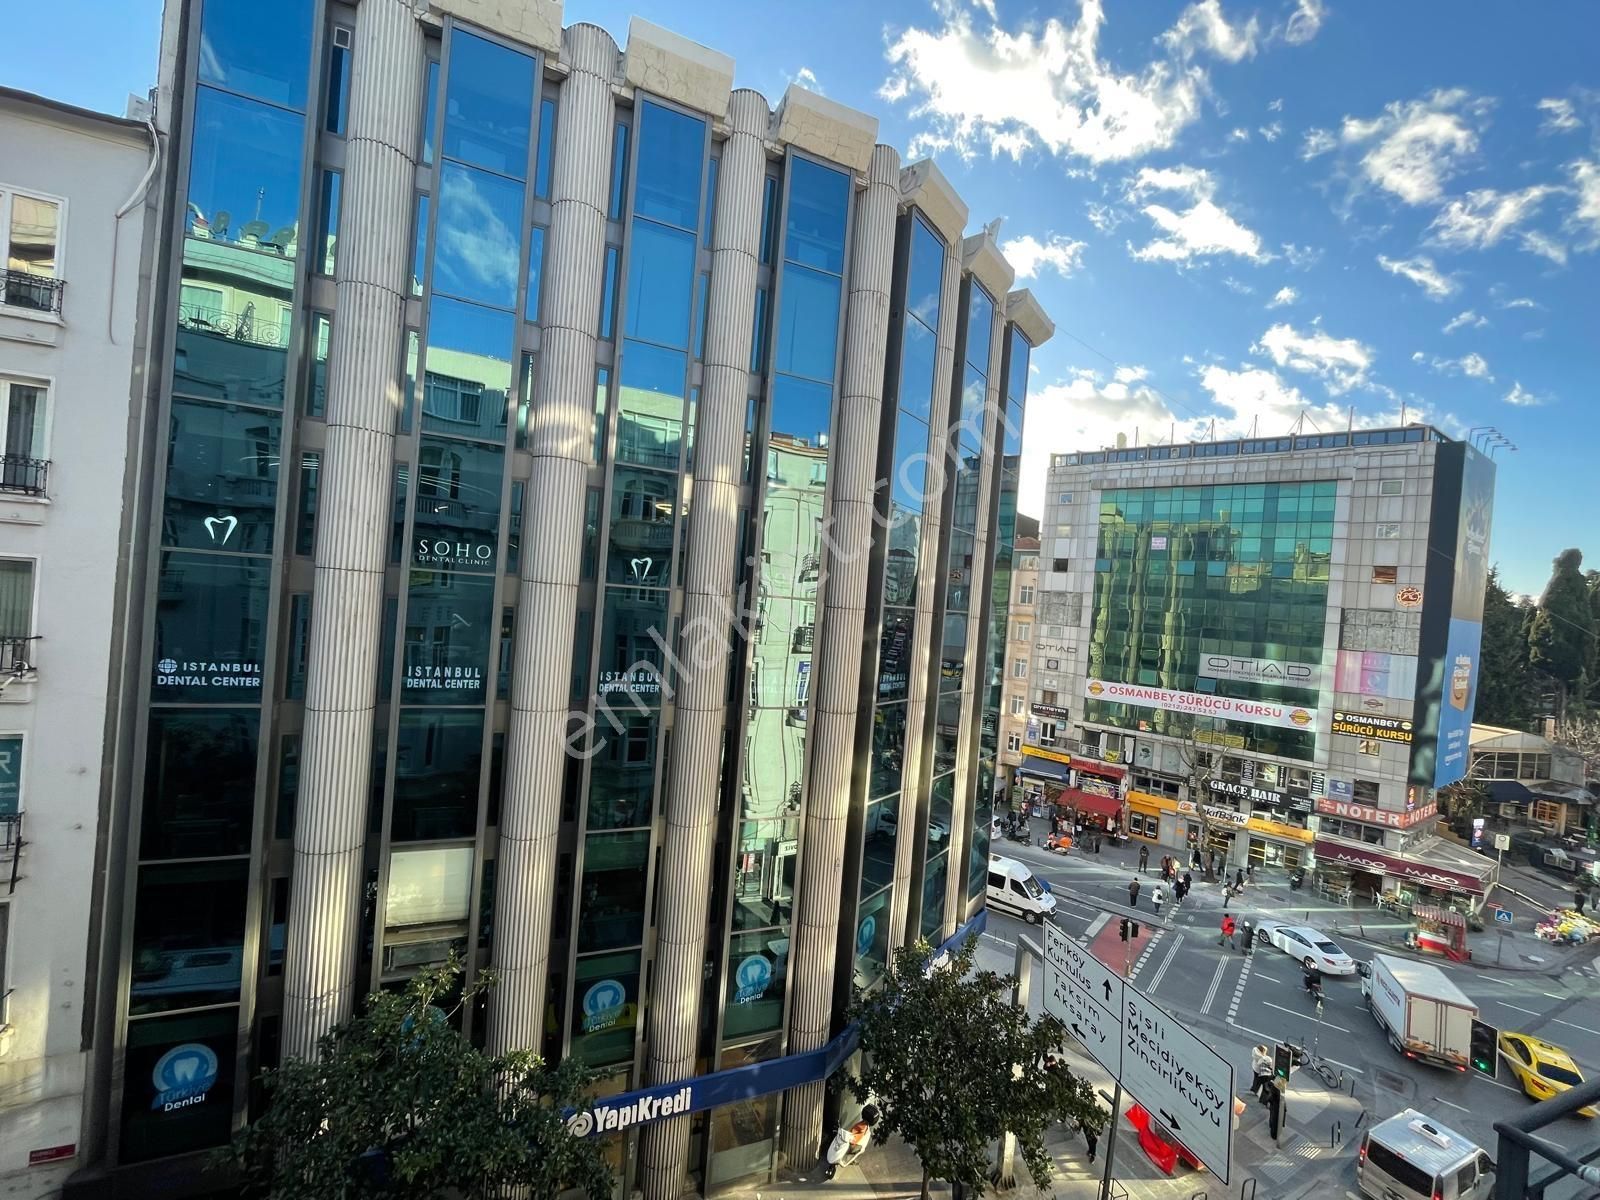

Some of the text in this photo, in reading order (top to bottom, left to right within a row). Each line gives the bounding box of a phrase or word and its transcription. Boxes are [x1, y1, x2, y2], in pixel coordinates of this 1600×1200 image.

[419, 539, 491, 559] SOHO
[418, 555, 489, 566] DENTAL CLINIC
[183, 662, 261, 673] ISTANBUL
[408, 665, 481, 678] ISTANBUL
[600, 671, 660, 682] ISTANBUL
[1208, 657, 1311, 677] OTIAD
[157, 675, 260, 687] DENTAL CENTER
[406, 678, 480, 689] DENTAL CENTER
[600, 683, 660, 693] DENTAL CENTER
[1109, 686, 1283, 718] OSMANBEY SÜRÜCÜ KURSU
[1346, 714, 1399, 728] OSMANBEY
[1332, 722, 1374, 736] SÜRÜCÜ
[1376, 728, 1413, 741] KURSU
[1210, 780, 1248, 797] GRACE
[1250, 788, 1281, 803] HAIR
[1336, 803, 1400, 826] NOTER
[1410, 803, 1433, 823] NOTER
[1337, 853, 1387, 869] MADO
[1405, 867, 1459, 885] MADO
[1047, 929, 1085, 969] Feriköy
[740, 991, 763, 1004] Dental
[1053, 971, 1101, 1021] Taksim
[1053, 988, 1106, 1043] Aksaray
[1128, 1000, 1165, 1040] Şişli
[588, 1019, 616, 1033] Dental
[1127, 1018, 1224, 1110] Mecidiyeköy
[1127, 1034, 1221, 1128] Zincirlikuyu
[164, 1093, 205, 1112] Dental
[593, 1086, 692, 1133] YapıKredi
